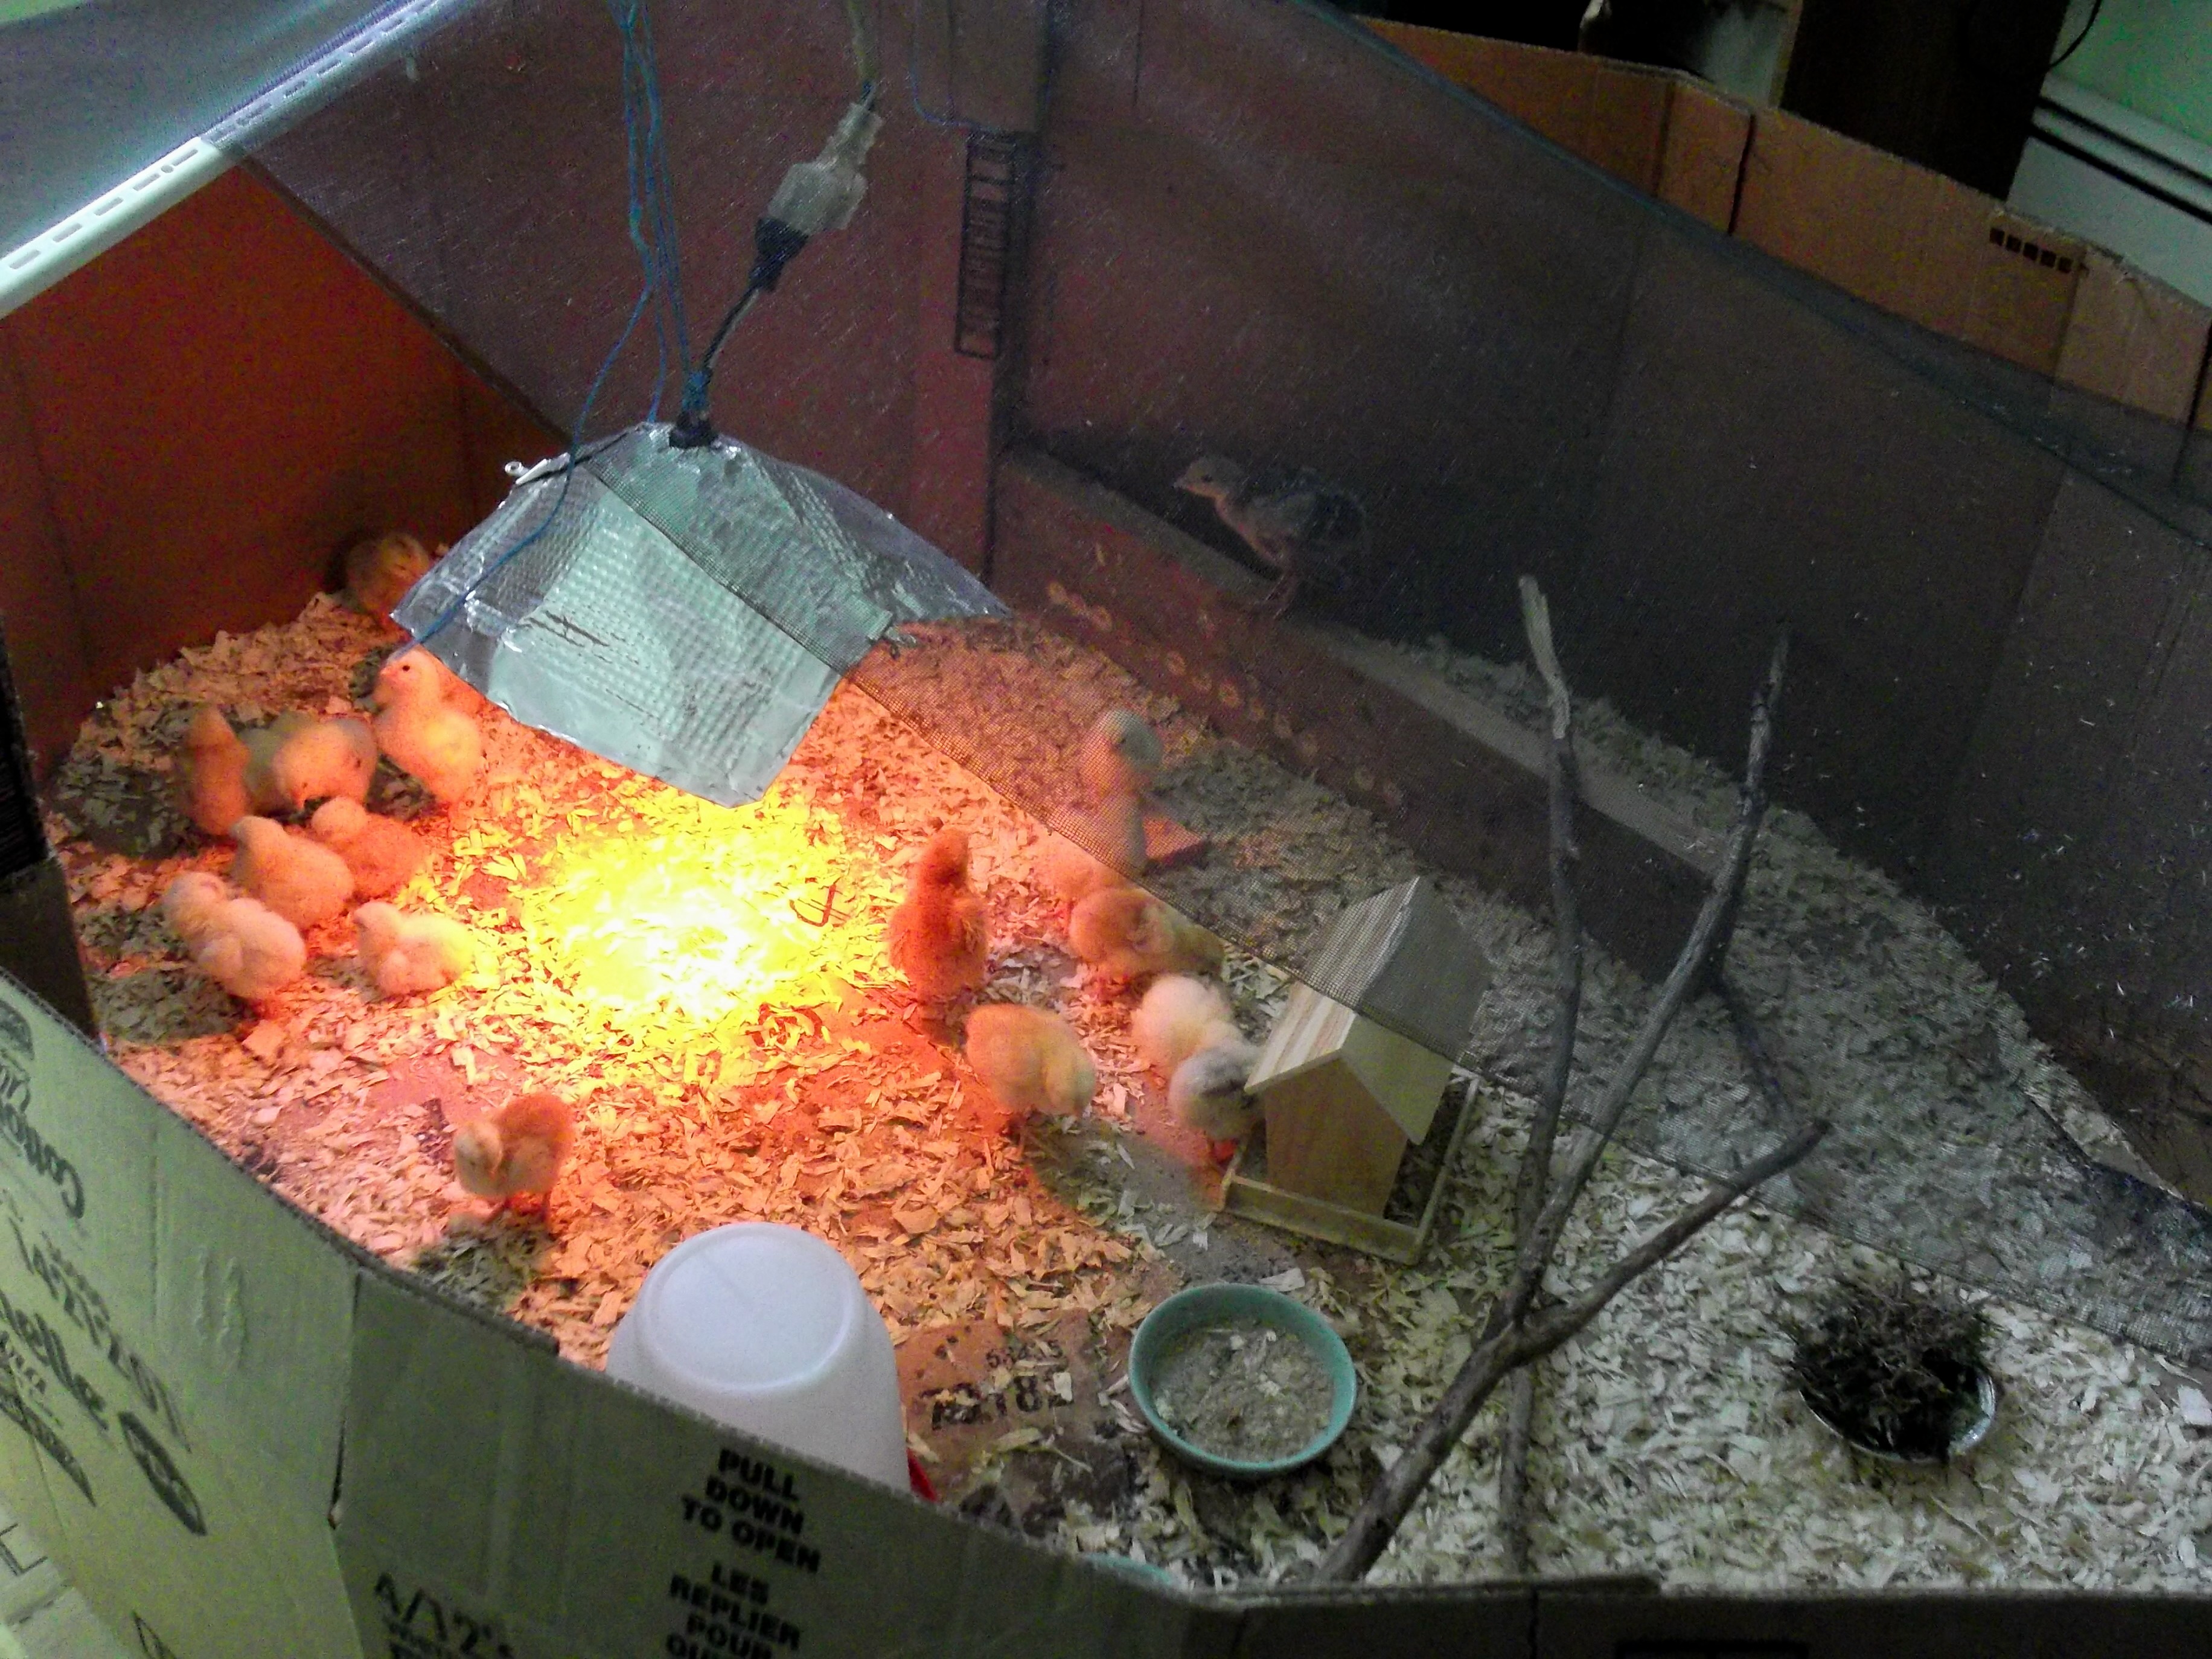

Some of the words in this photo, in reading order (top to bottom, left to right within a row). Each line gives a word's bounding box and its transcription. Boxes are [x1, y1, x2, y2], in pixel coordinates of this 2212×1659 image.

[718, 1448, 798, 1500] PULL
[706, 1475, 804, 1534] DOWN
[682, 1494, 723, 1531] TO
[732, 1520, 821, 1573] OPEN
[711, 1560, 769, 1605] LES
[670, 1574, 801, 1651] REPLIER
[687, 1613, 772, 1659] POUR
